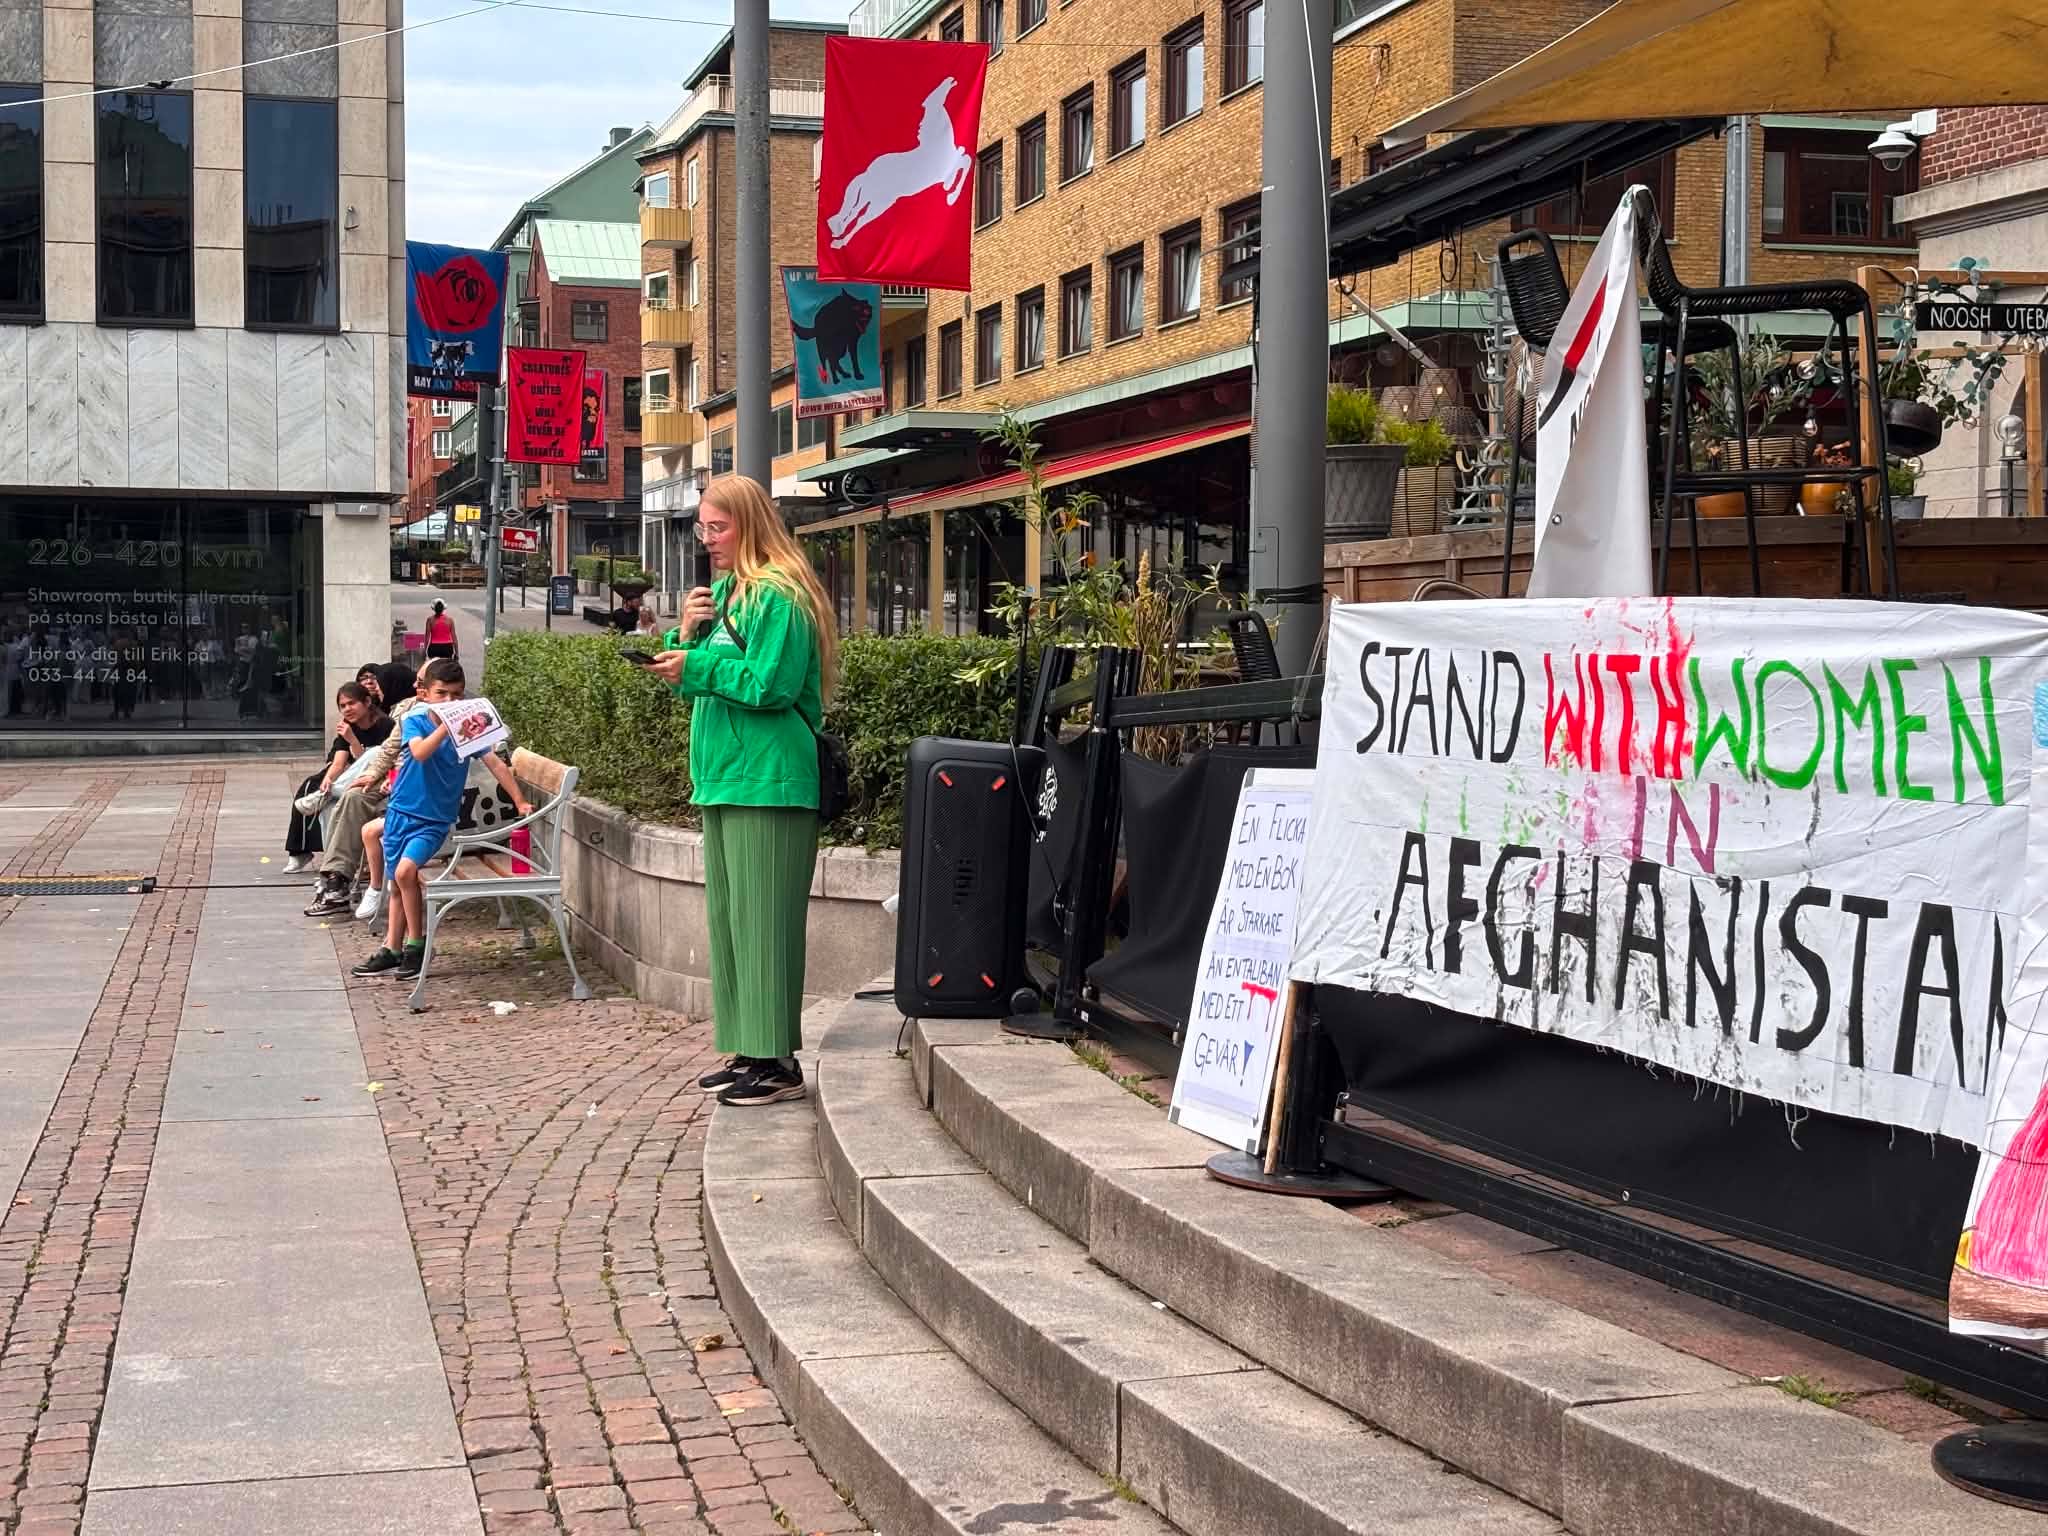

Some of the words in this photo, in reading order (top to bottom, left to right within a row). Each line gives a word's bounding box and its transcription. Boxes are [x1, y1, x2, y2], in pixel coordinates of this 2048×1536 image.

[1930, 306, 1992, 328] NOOSH
[414, 375, 432, 388] HAY
[191, 541, 264, 568] kvm
[27, 586, 127, 606] Showroom,
[28, 608, 51, 631] på
[56, 611, 104, 625] stans
[109, 609, 158, 625] bästa
[29, 646, 62, 661] Hör
[65, 649, 87, 661] av
[91, 646, 118, 665] dig
[124, 646, 145, 661] till
[151, 646, 182, 661] Erik
[187, 647, 209, 665] på
[100, 667, 121, 683] 74
[126, 667, 153, 682] 84.
[1355, 640, 1526, 764] STAND
[1543, 648, 1695, 782] WITH
[1687, 655, 2009, 807] WOMEN
[1630, 774, 1721, 875] IN
